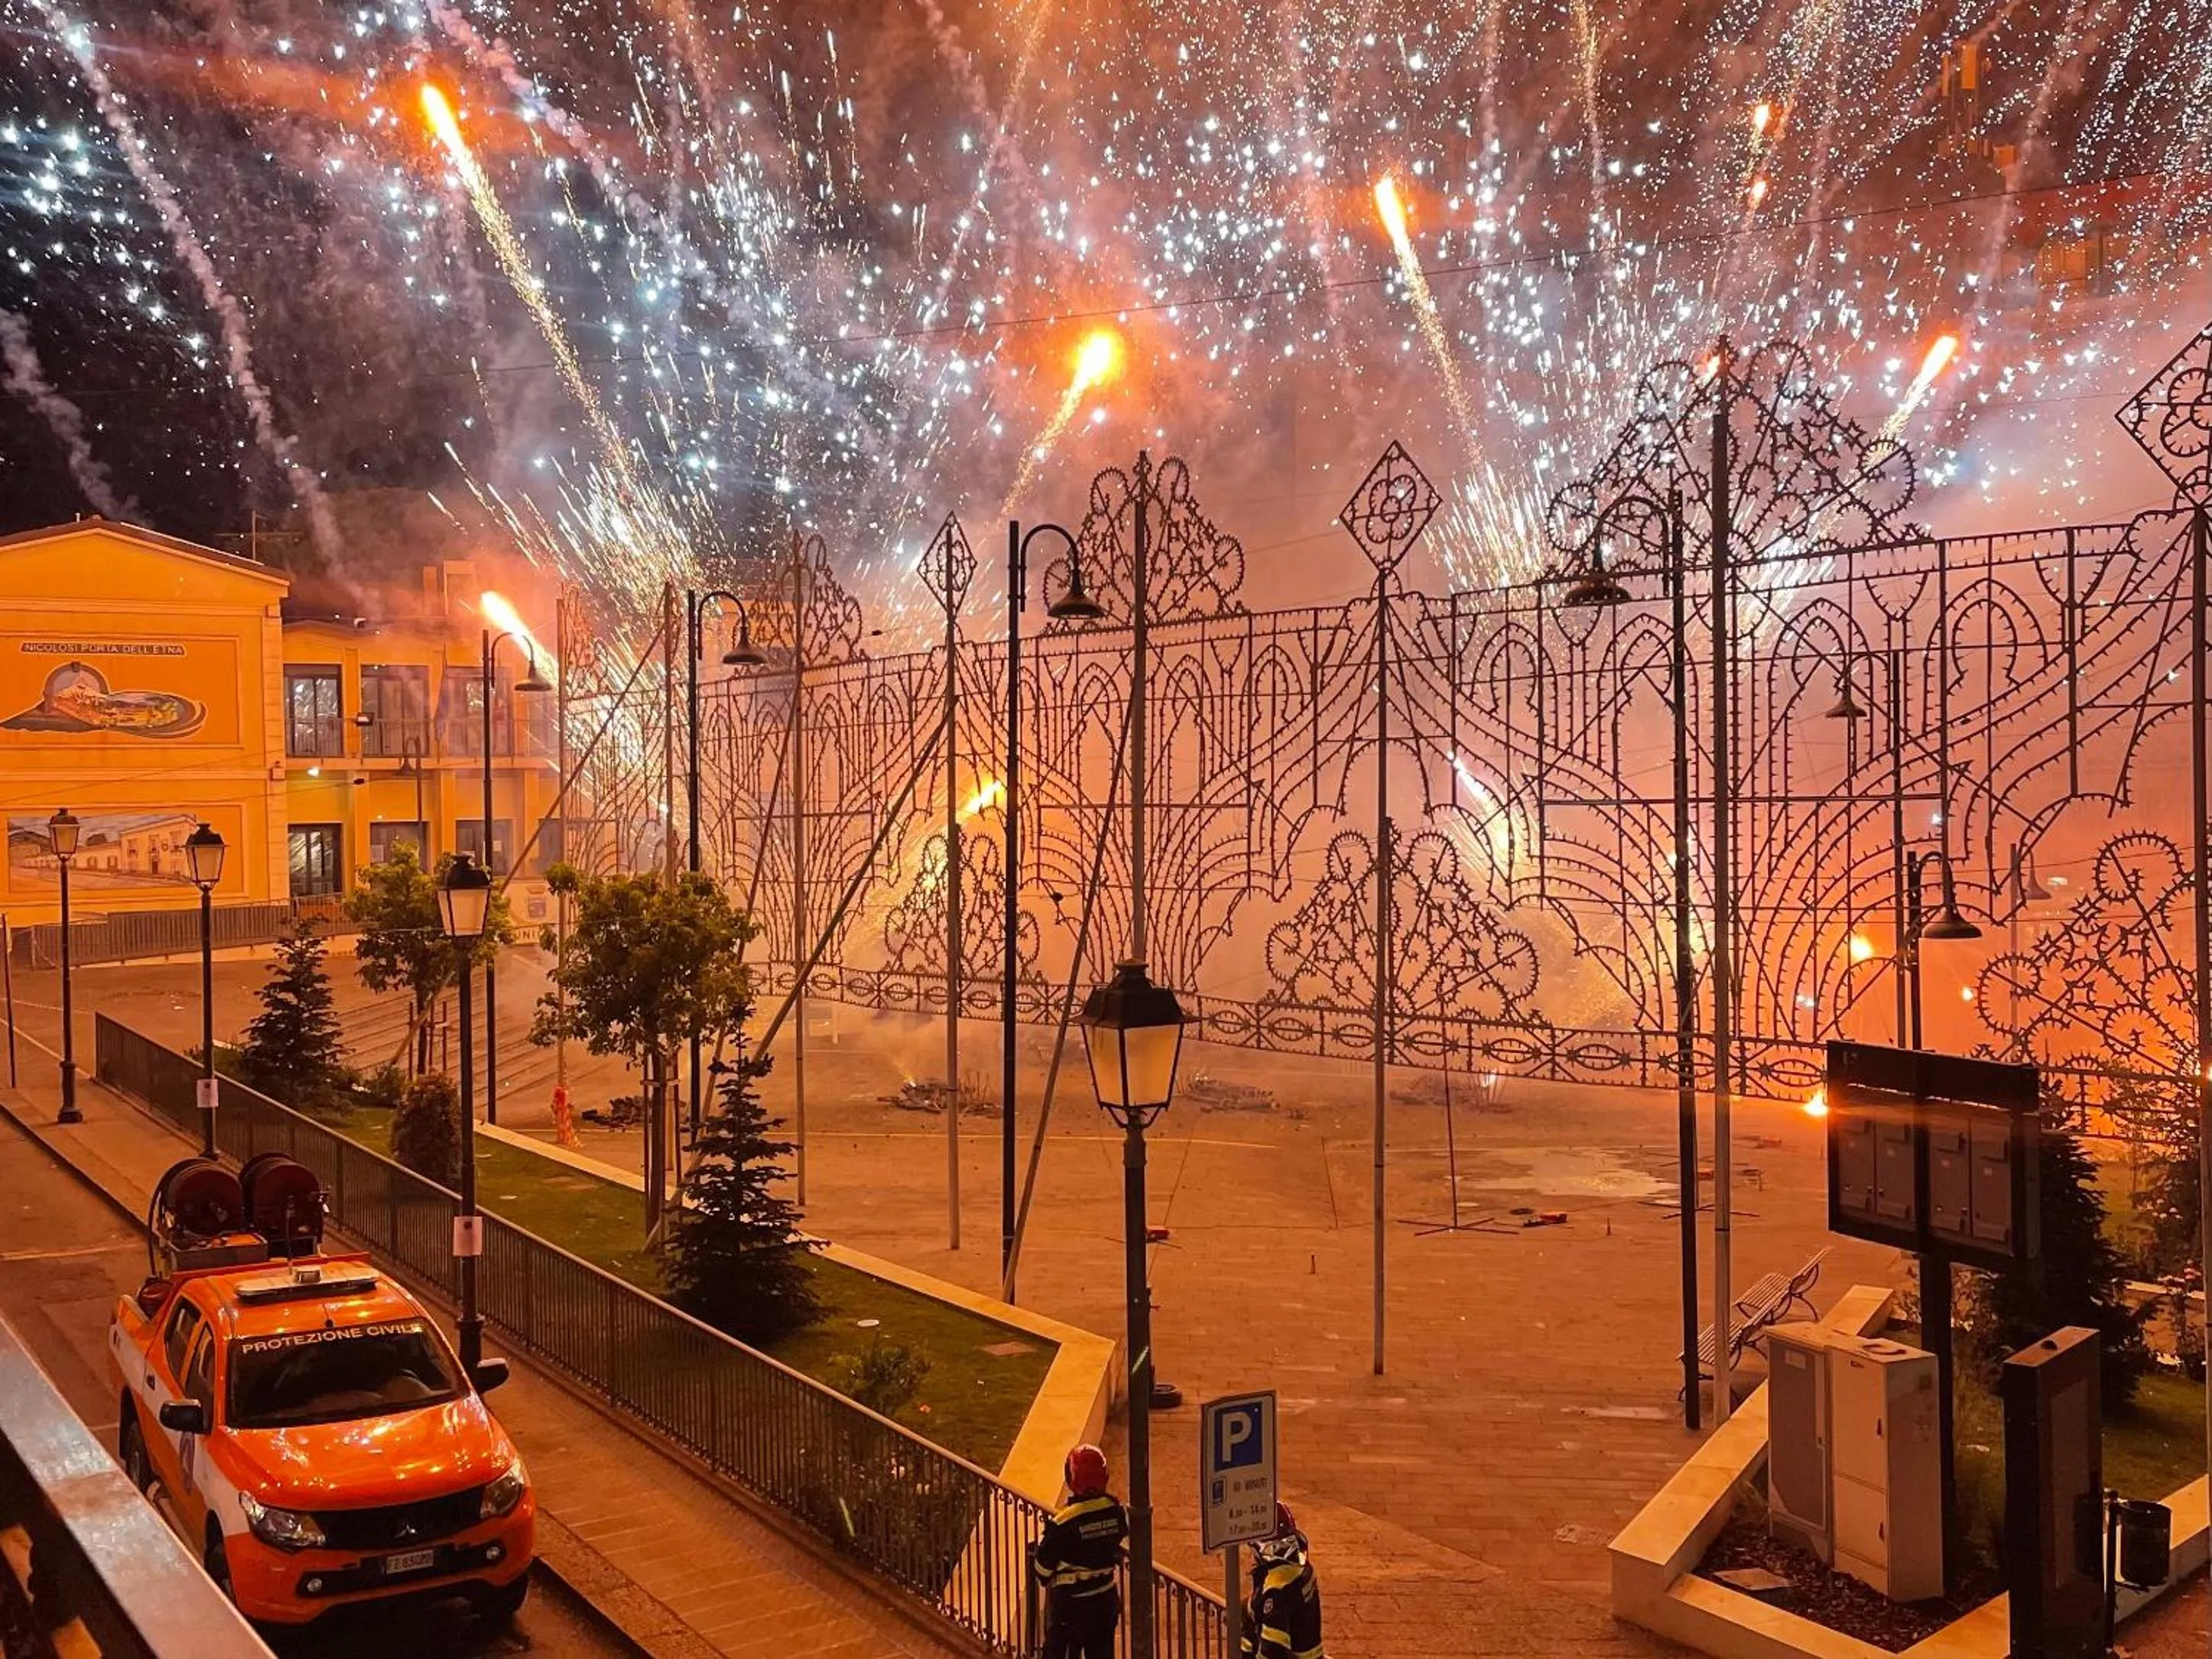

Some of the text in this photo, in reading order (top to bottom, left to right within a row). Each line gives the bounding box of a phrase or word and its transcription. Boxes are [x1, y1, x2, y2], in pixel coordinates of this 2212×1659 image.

[24, 643, 78, 652] NICOLOSI
[80, 644, 119, 654] PORTA
[242, 1323, 423, 1354] PROTEZIONE CIVILE
[1222, 1411, 1252, 1463] P
